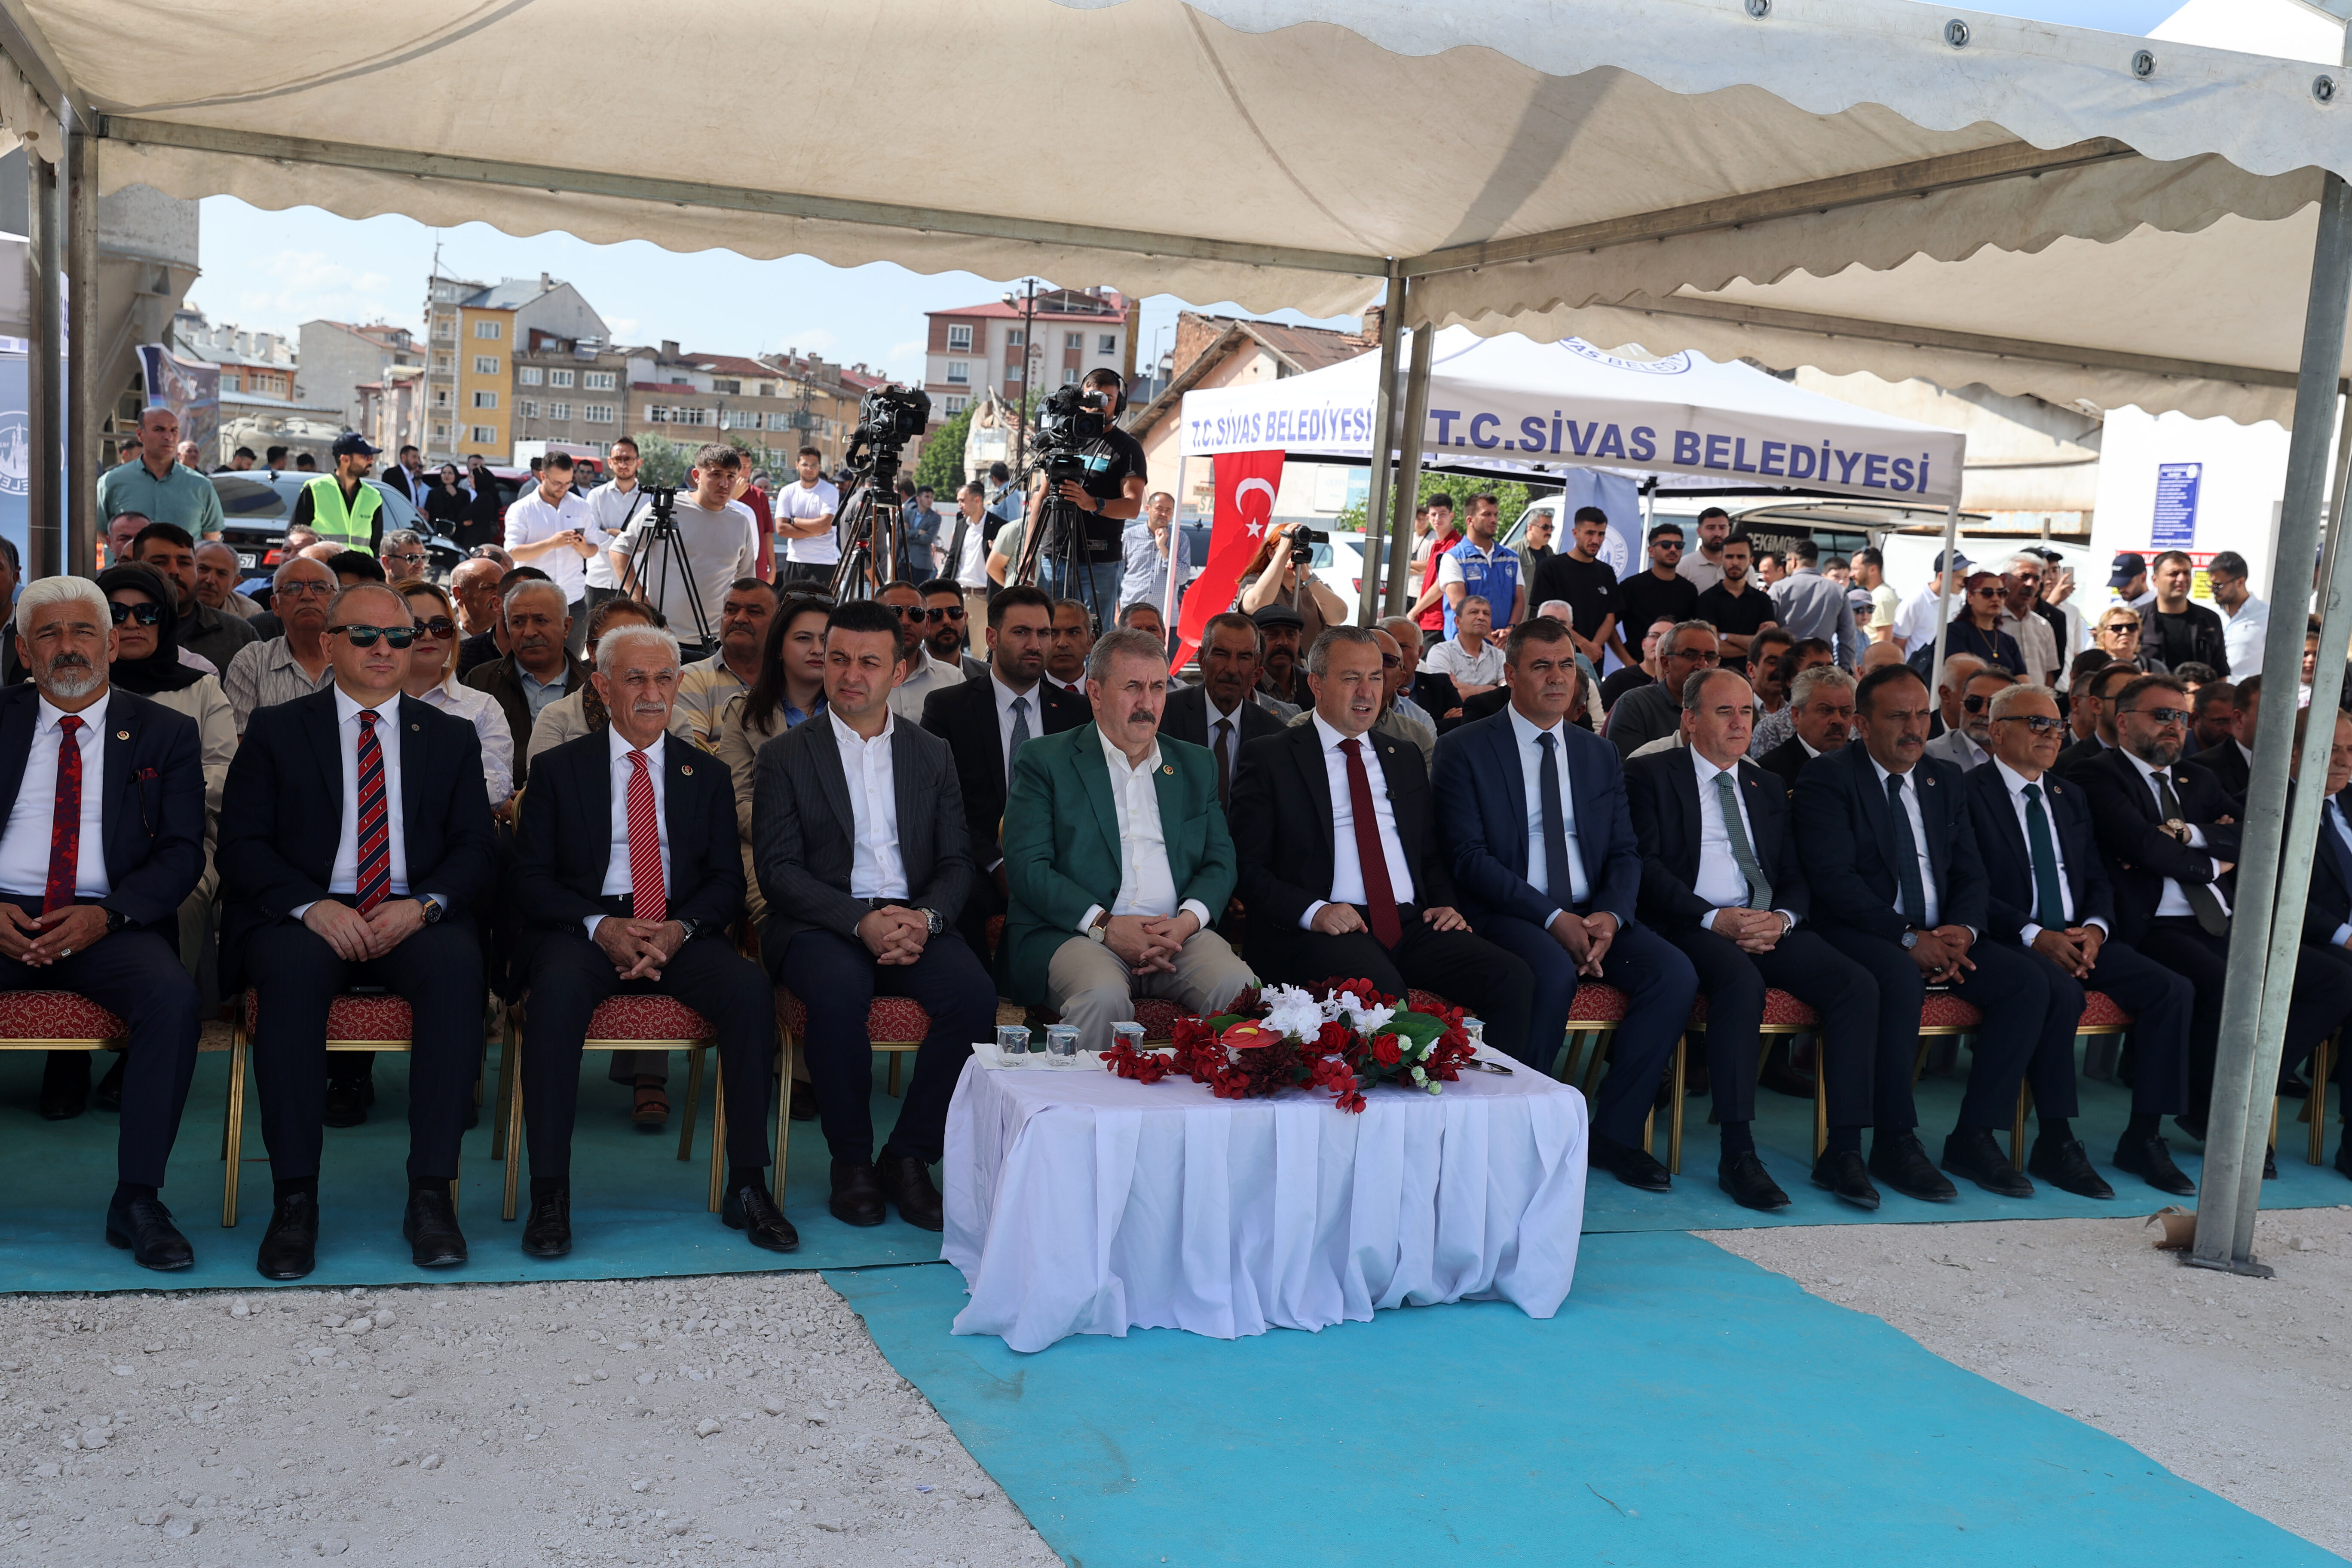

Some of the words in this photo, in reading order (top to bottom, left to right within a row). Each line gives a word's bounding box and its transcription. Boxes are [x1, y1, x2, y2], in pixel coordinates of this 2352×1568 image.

[1265, 398, 1375, 442] BELEDİYESİ
[1429, 409, 1656, 462] T.C.SİVAS
[1673, 430, 1930, 494] BELEDİYESİ
[1200, 496, 1215, 511] SA
